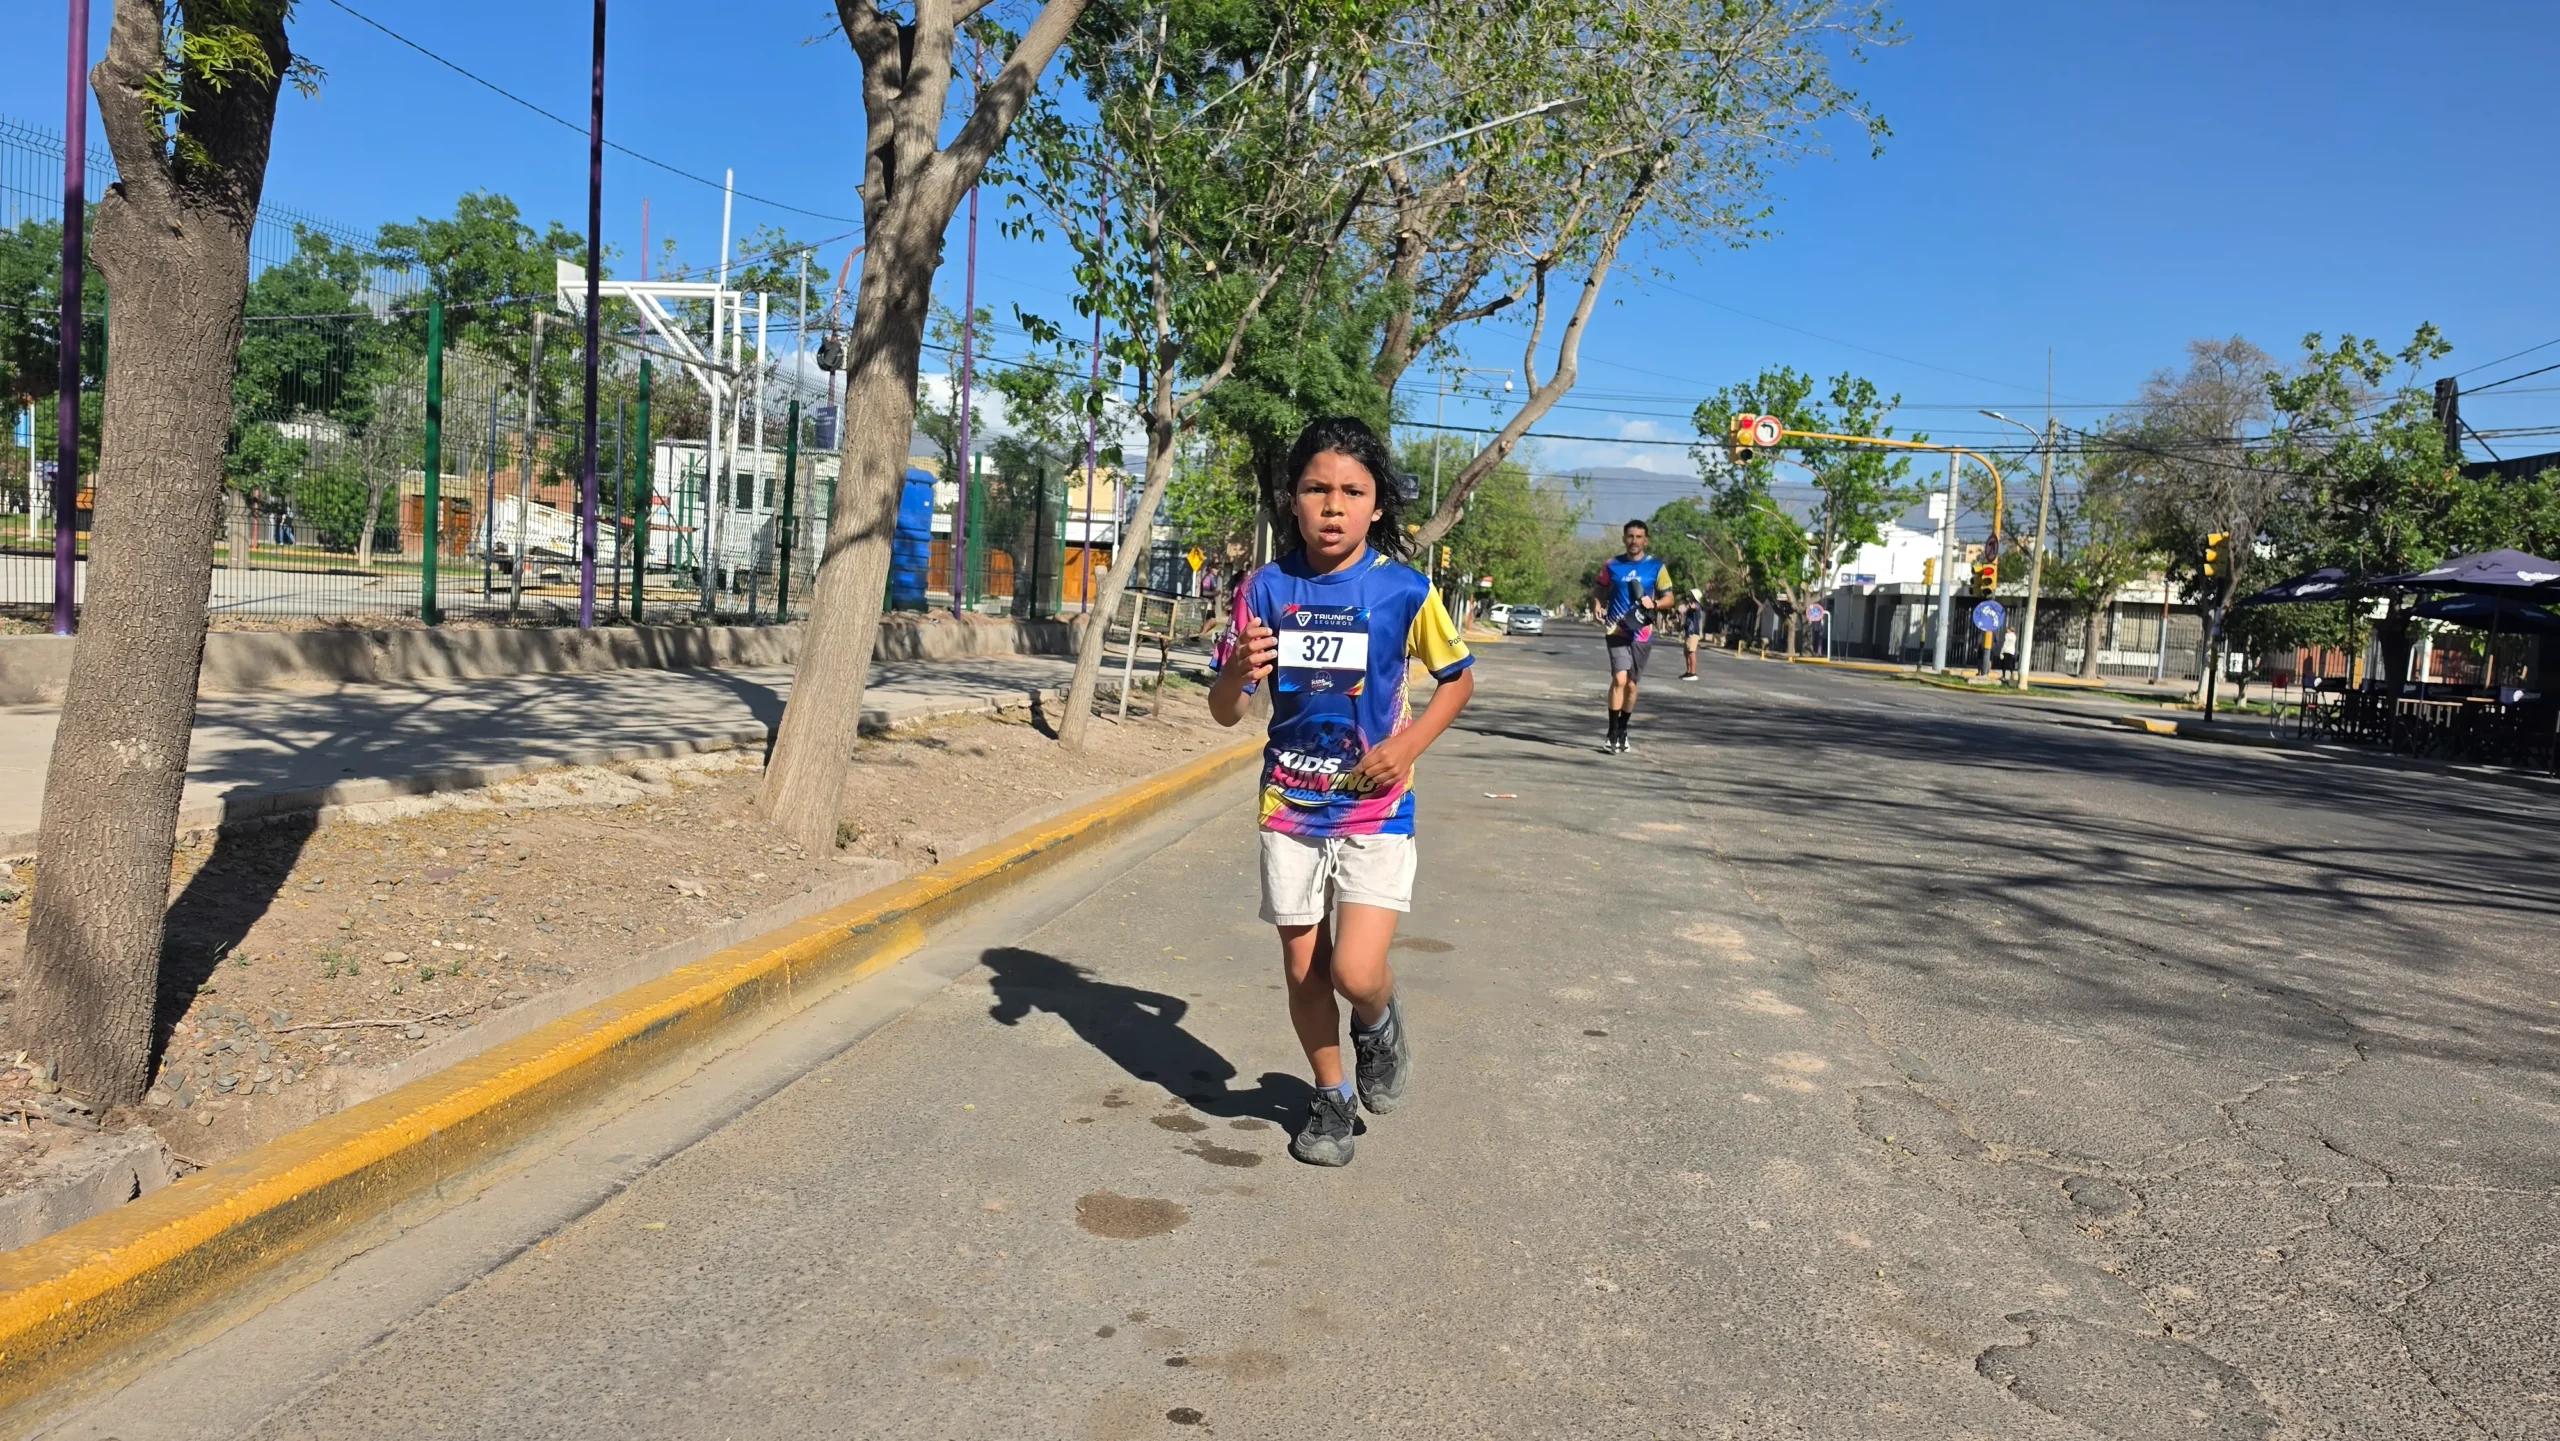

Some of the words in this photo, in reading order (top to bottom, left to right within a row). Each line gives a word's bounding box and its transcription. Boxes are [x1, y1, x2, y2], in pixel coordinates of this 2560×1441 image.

[1314, 613, 1354, 621] TRIUNFO
[1302, 635, 1344, 663] 327
[1278, 751, 1342, 774] KIDS
